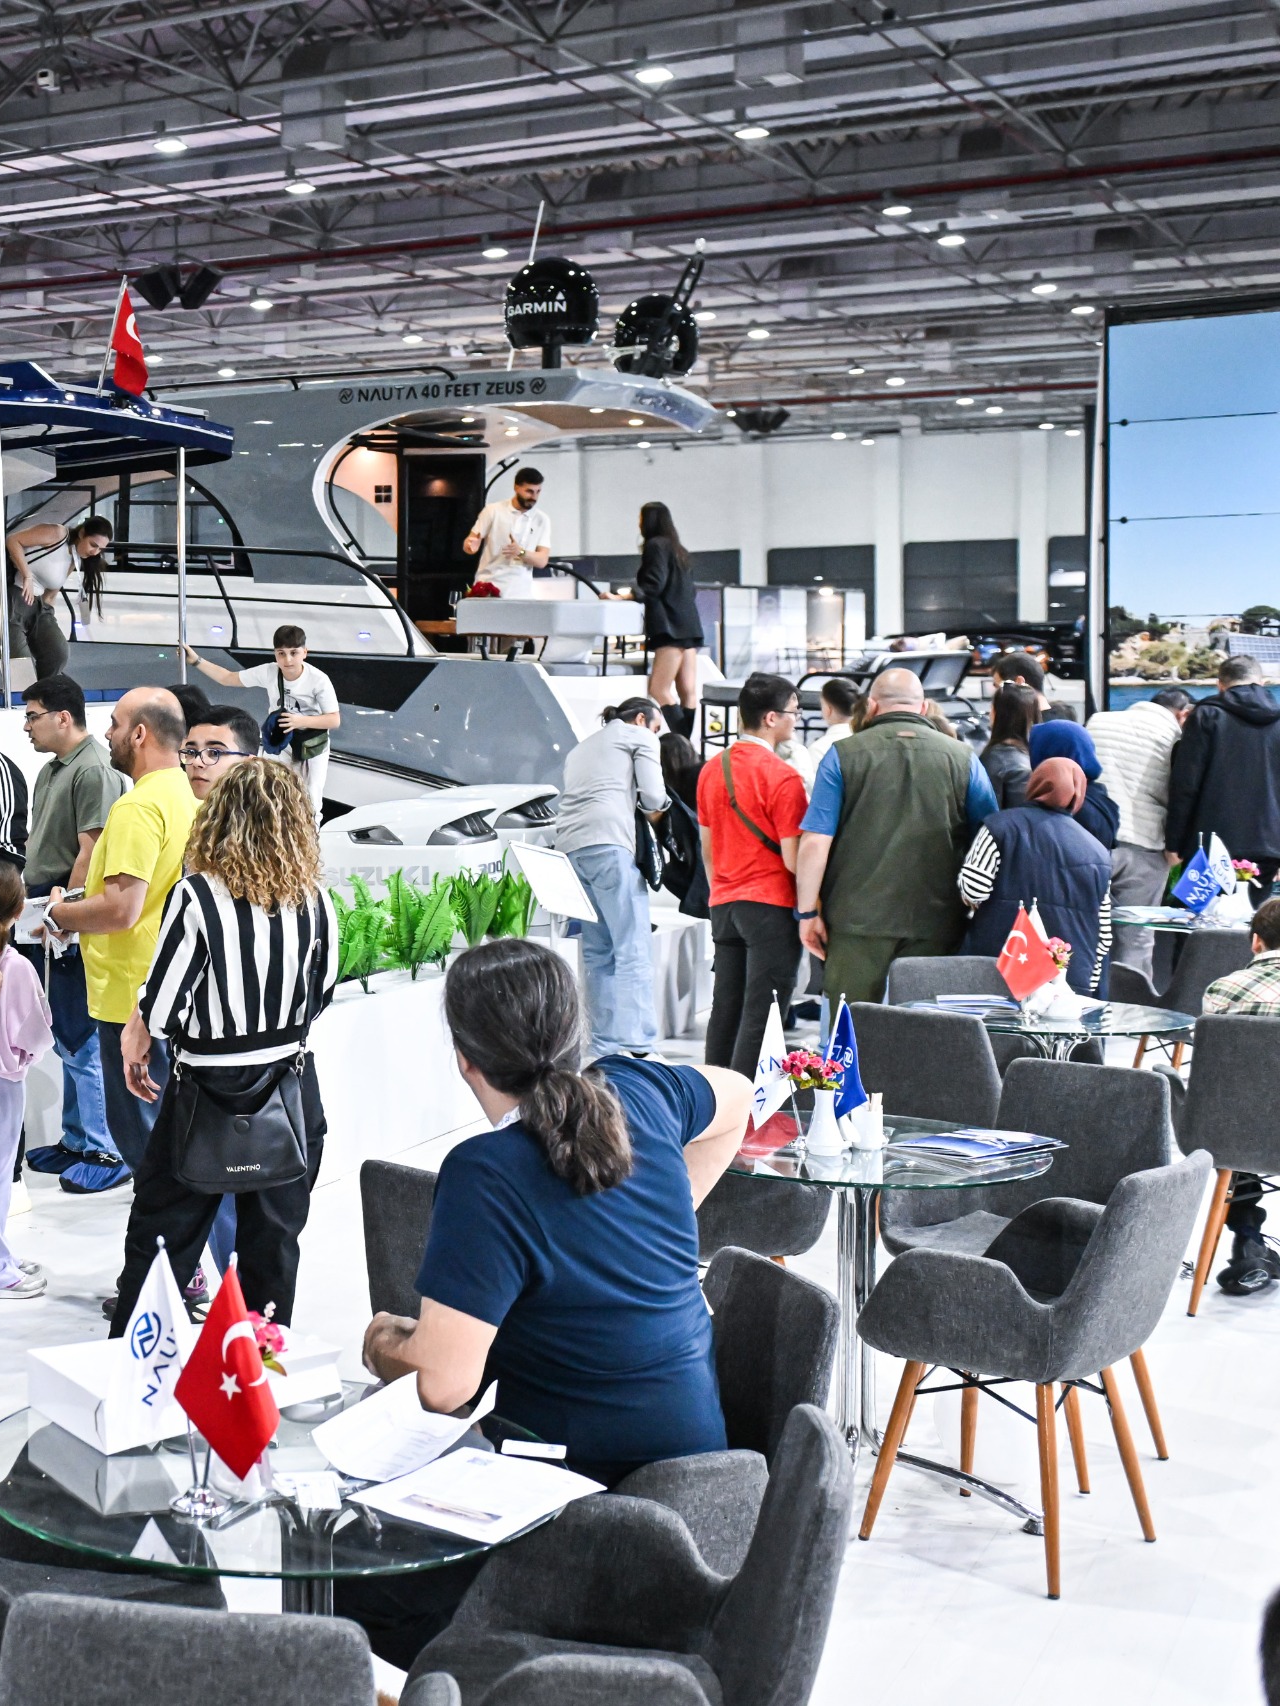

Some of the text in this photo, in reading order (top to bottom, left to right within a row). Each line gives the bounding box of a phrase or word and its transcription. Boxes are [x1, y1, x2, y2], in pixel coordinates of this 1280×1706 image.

[507, 300, 567, 317] GARMIN
[357, 380, 525, 403] NAUTA 40 FEET ZEUS
[324, 865, 430, 888] SUZUKI
[478, 860, 503, 874] 300
[1185, 868, 1216, 905] NAUT
[226, 1163, 261, 1173] VALENTINO
